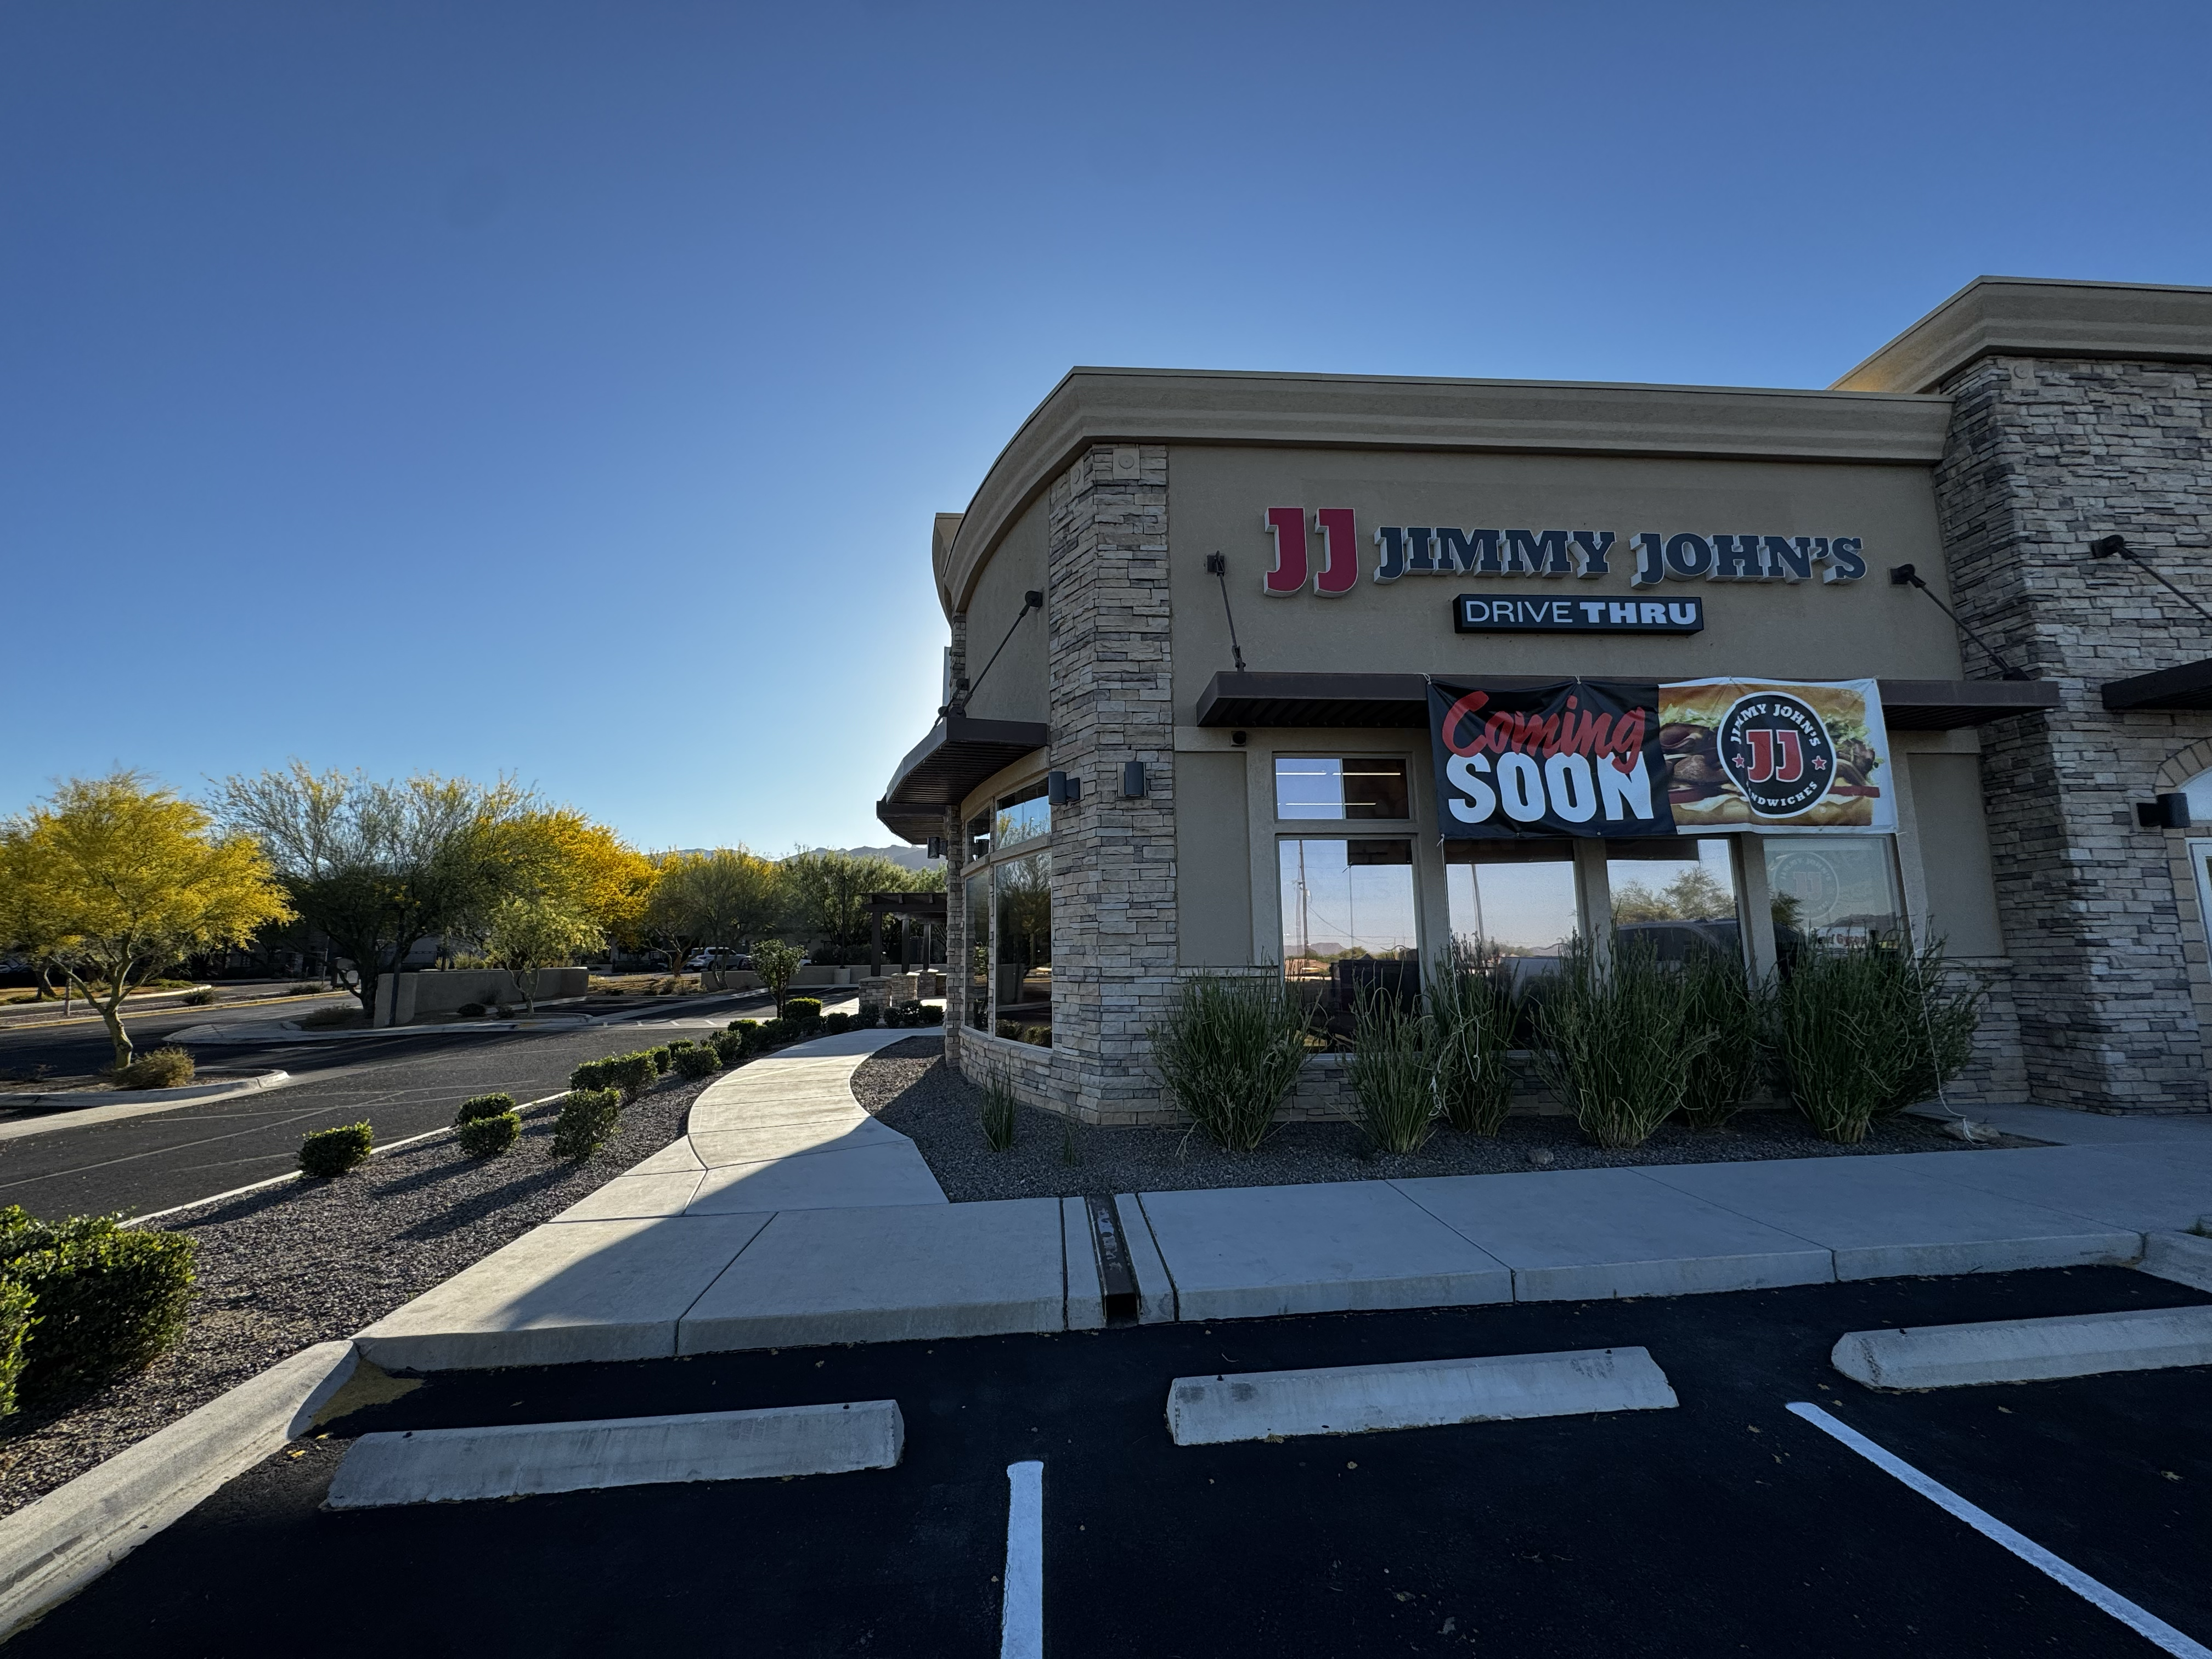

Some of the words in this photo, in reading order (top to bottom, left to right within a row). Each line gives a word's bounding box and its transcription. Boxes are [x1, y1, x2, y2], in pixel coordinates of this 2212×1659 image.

[1263, 507, 1359, 598] JJ
[1373, 526, 1616, 585] JIMMY
[1628, 532, 1867, 590] JOHN'S
[1465, 600, 1573, 624] DRIVE
[1579, 601, 1697, 625] THRU
[1442, 690, 1646, 774] Coming
[1730, 703, 1767, 745] JIMMY
[1773, 703, 1822, 747] JOHN'S
[1746, 729, 1804, 783] JJ
[1446, 752, 1655, 823] SOON
[1746, 781, 1818, 807] NDWICHES
